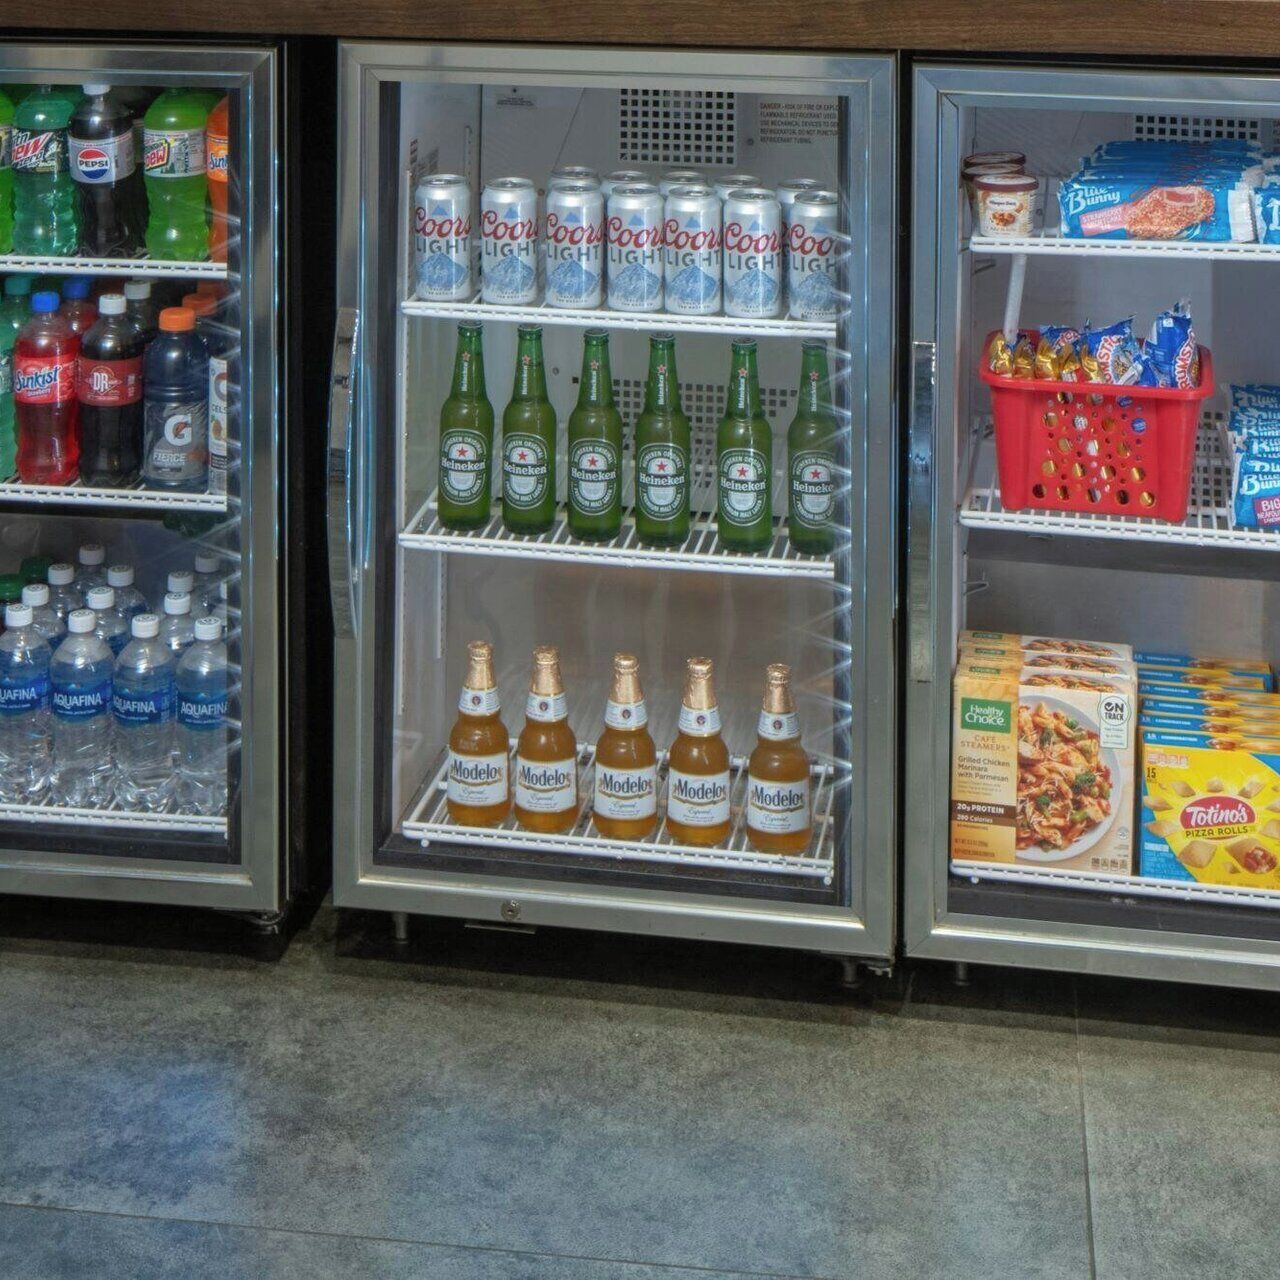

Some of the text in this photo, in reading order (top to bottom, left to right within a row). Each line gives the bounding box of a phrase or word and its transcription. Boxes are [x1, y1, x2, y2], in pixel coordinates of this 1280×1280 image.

[78, 159, 110, 168] PEPSI
[15, 365, 63, 393] Sunkist
[164, 414, 192, 447] G
[152, 452, 188, 462] FIERCE
[440, 456, 486, 471] Heineken
[503, 460, 547, 476] Heineken
[571, 467, 617, 482] Heineken
[639, 472, 685, 487] Heineken
[720, 477, 767, 492] Heineken
[53, 692, 103, 710] AQUAFINA
[970, 703, 1005, 718] Healthy
[1104, 711, 1125, 722] TRACK
[964, 713, 1006, 727] Choice
[958, 755, 1011, 768] Grilled Chicken
[958, 763, 989, 773] Marinara
[453, 759, 498, 781] Modelo
[521, 765, 567, 786] Modelo
[957, 771, 1010, 783] with Parmesan
[1146, 767, 1157, 780] 15
[603, 771, 648, 794] Modelo
[676, 777, 722, 800] Modelo
[754, 785, 800, 808] Modelo
[971, 804, 1005, 815] PROTEIN
[1185, 798, 1249, 826] Totino's
[1184, 825, 1249, 838] PIZZA ROLLS
